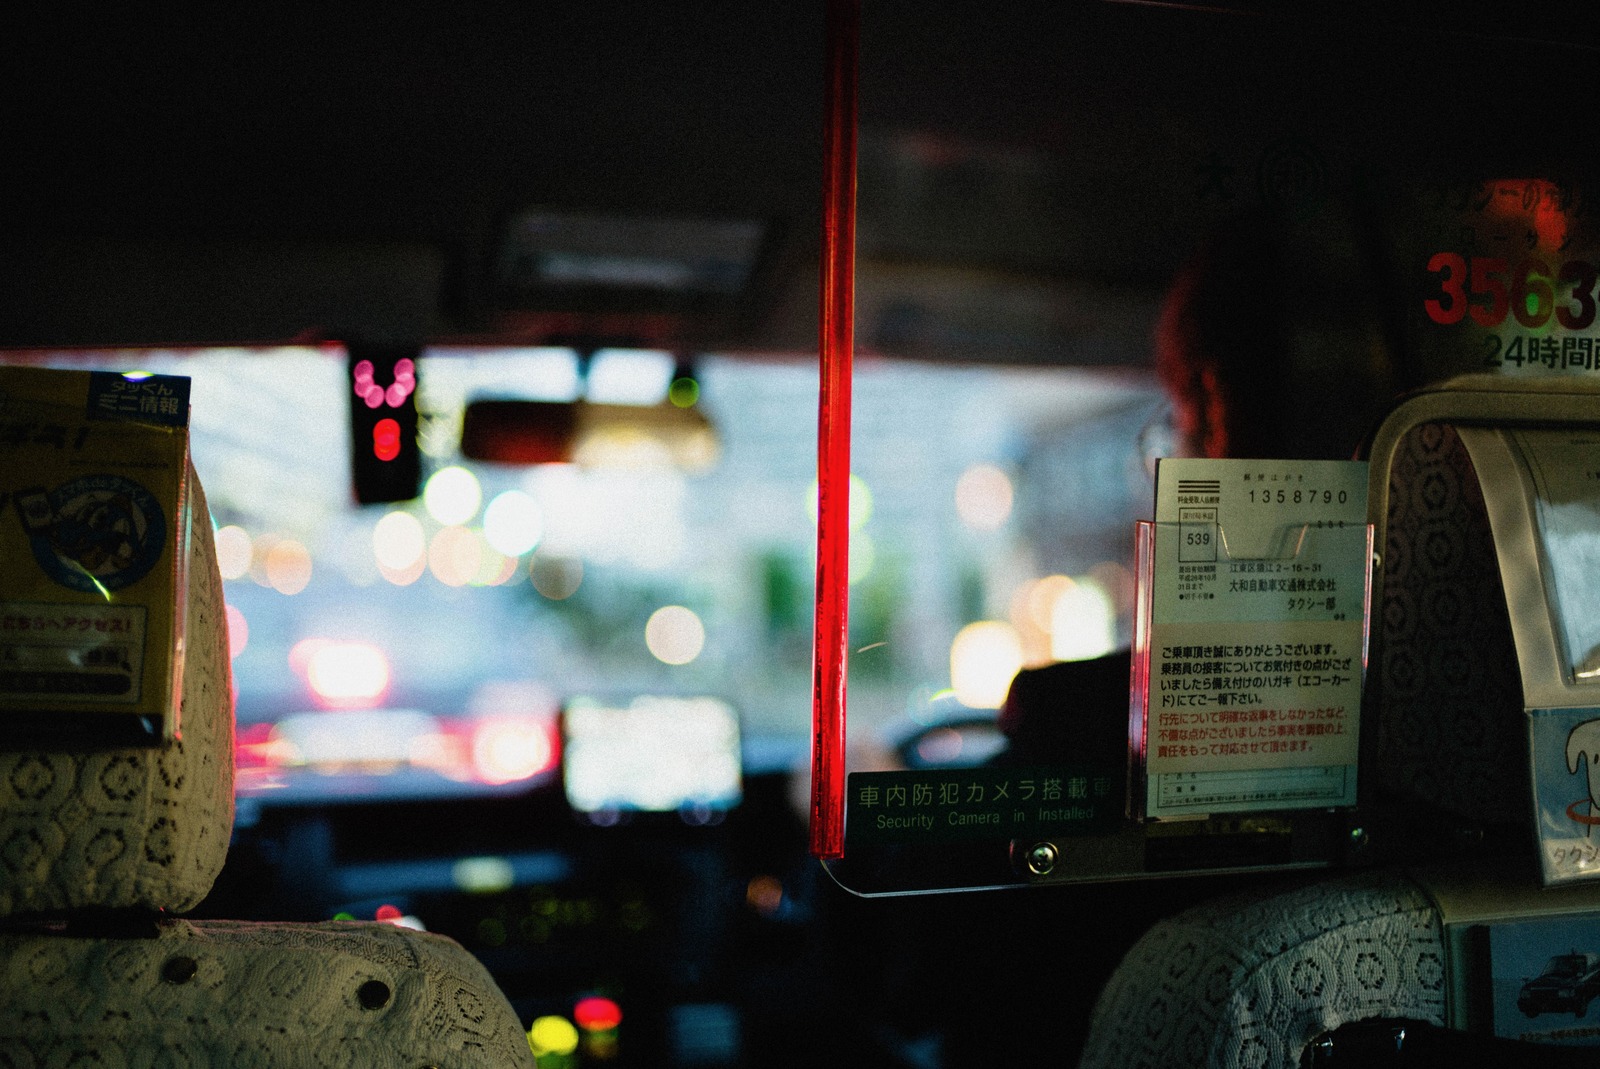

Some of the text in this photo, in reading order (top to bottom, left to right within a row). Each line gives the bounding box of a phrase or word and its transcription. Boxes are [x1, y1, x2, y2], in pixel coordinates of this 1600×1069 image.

[1424, 252, 1600, 330] 3563
[99, 393, 179, 414] ミニ情報
[1249, 490, 1347, 504] 1358790
[1187, 533, 1209, 545] 539
[1229, 579, 1336, 592] 大和自動車交通株式会社
[1288, 597, 1336, 611] タクシー部
[1162, 644, 1337, 659] ご乗車頂き誠にありがとうございます。
[1161, 658, 1351, 676] 乗務員の接客についてお気付きの点がござ
[1158, 741, 1312, 758] 責任をもって対応させて頂きます。
[877, 807, 1094, 830] Security Camera in Installed
